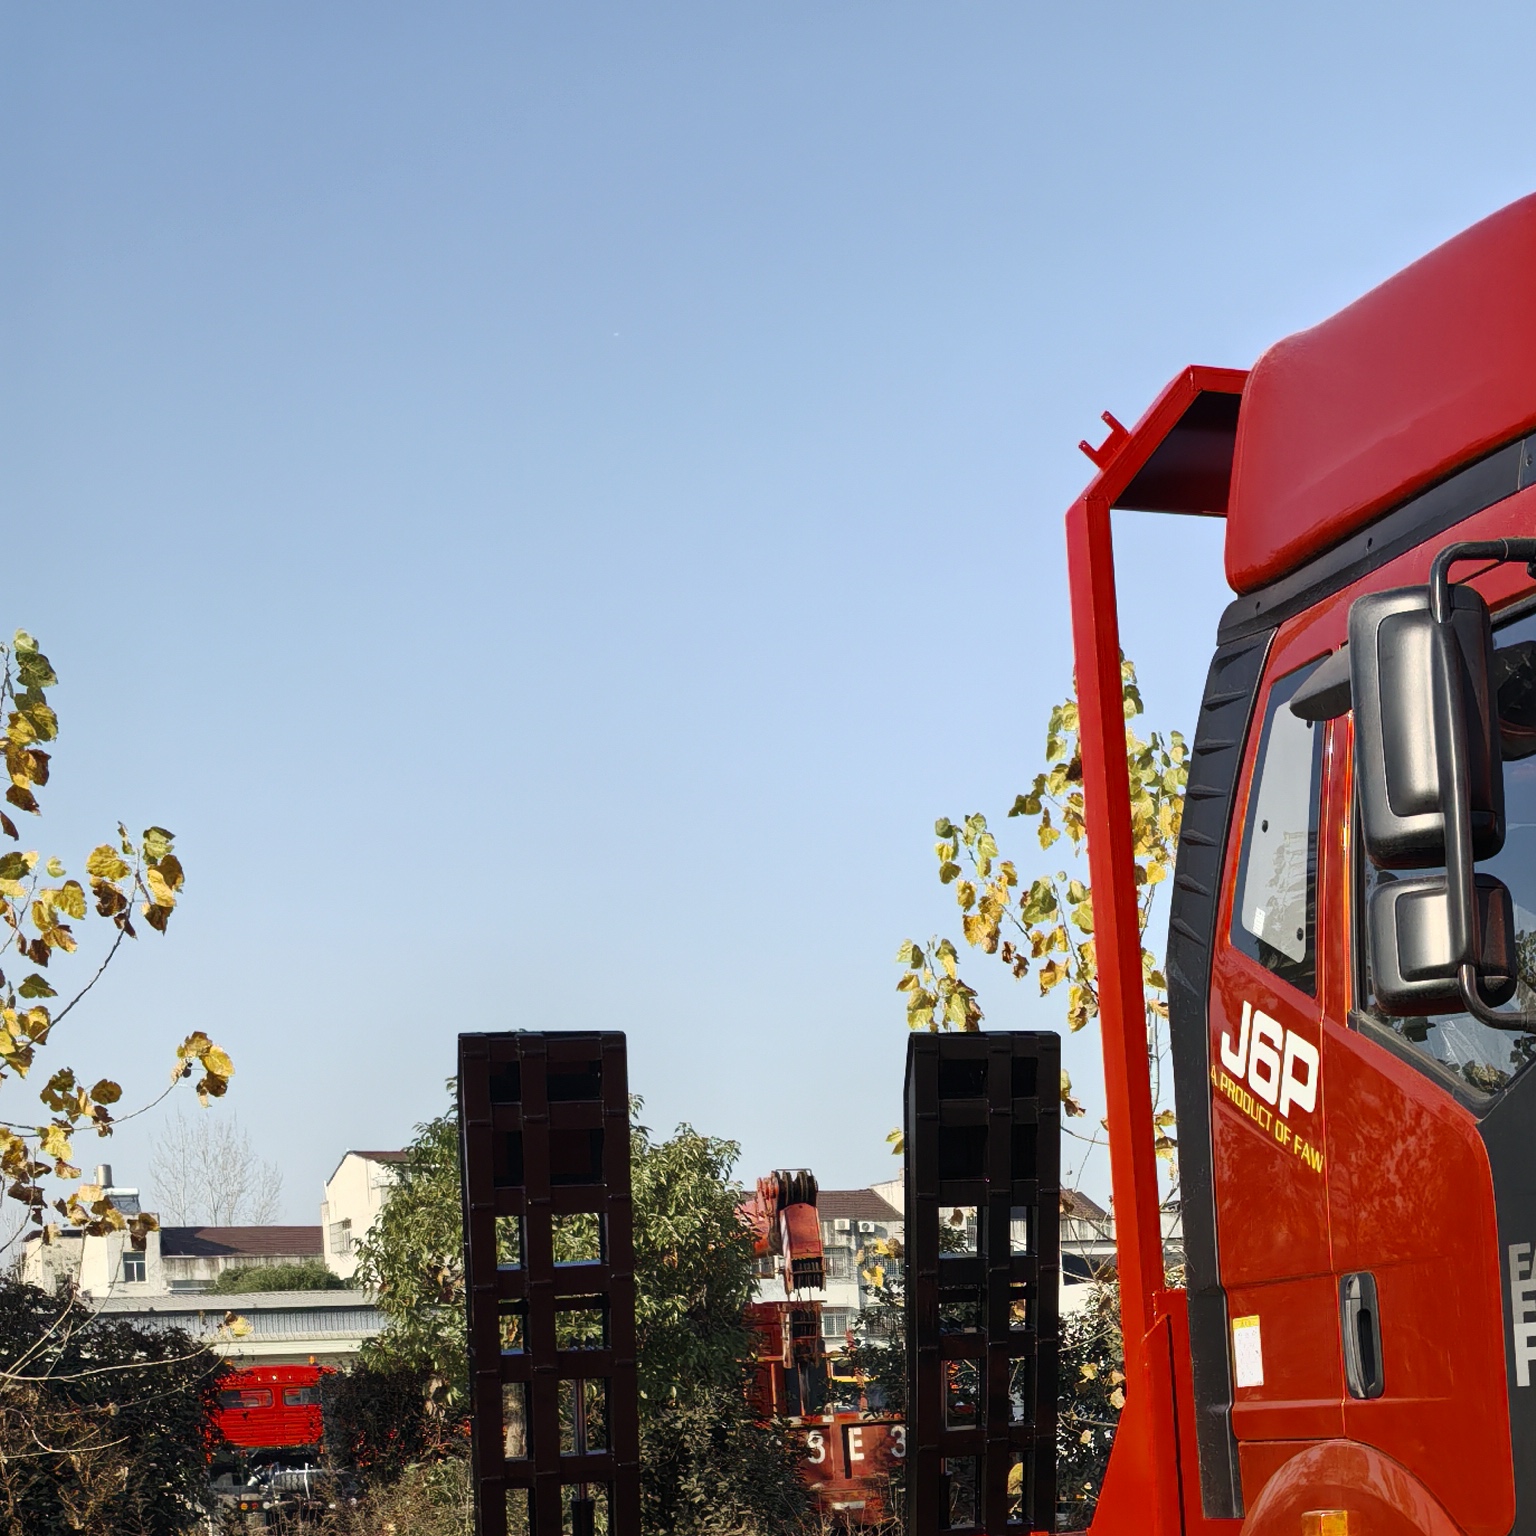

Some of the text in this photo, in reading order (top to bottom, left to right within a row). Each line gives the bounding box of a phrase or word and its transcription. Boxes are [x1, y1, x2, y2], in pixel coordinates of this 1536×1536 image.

[1220, 1000, 1320, 1119] J6P
[1210, 1065, 1324, 1174] A PRODUCT OF FAW
